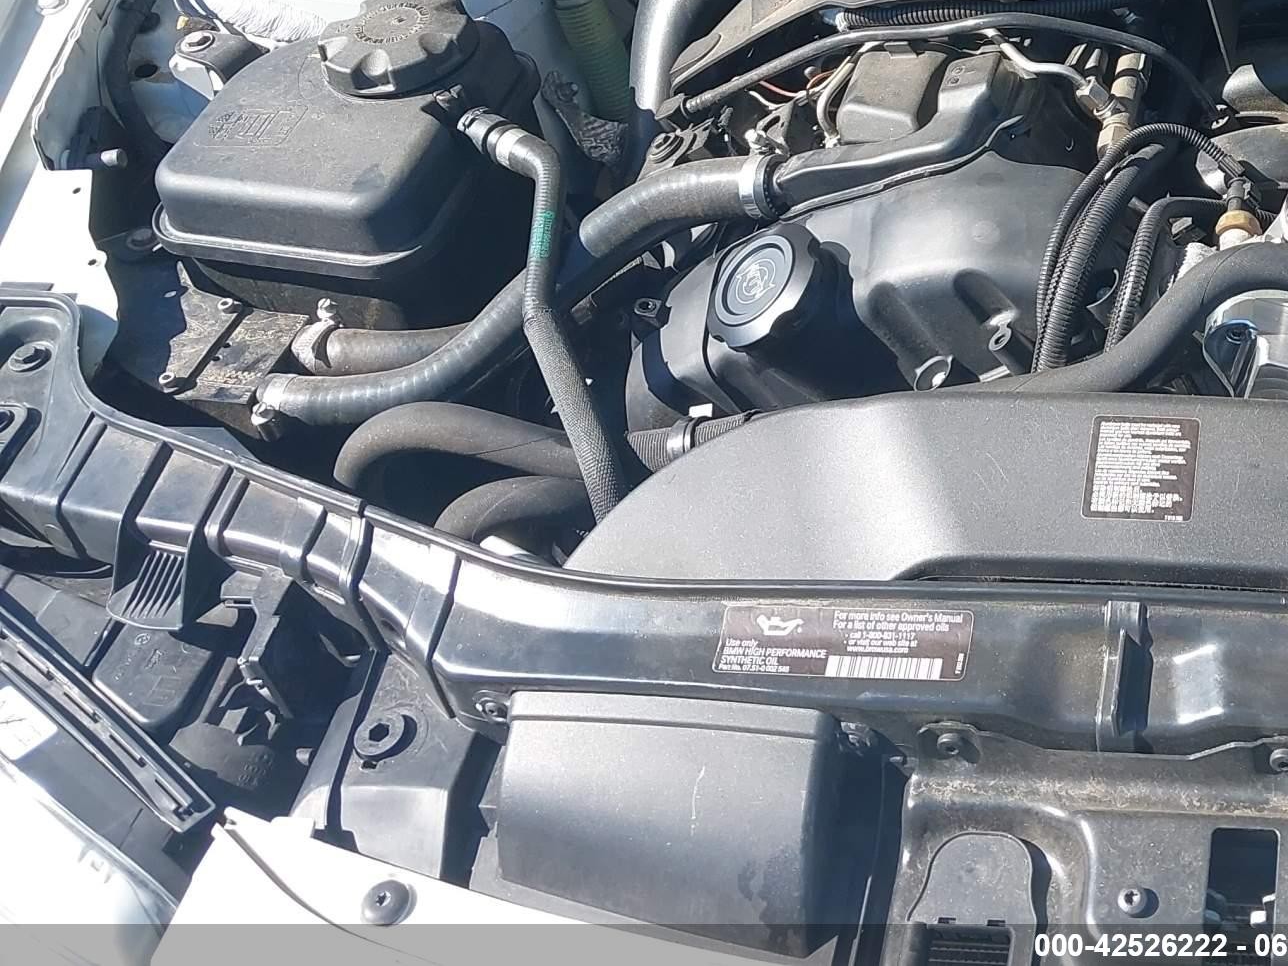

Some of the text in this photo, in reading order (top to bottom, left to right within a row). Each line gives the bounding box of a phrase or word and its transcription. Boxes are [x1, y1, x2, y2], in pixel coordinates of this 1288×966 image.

[834, 610, 963, 623] For more info see Owner's Manual
[833, 620, 847, 629] For
[853, 621, 866, 629] list
[867, 621, 875, 629] of
[876, 621, 897, 630] other
[898, 623, 935, 632] approved
[935, 623, 949, 632] oils
[849, 631, 861, 639] call
[725, 638, 759, 649] Use only
[723, 646, 827, 659] BMW HIGH PERFORMANCE
[720, 655, 779, 666] SYNTHETIC OIL
